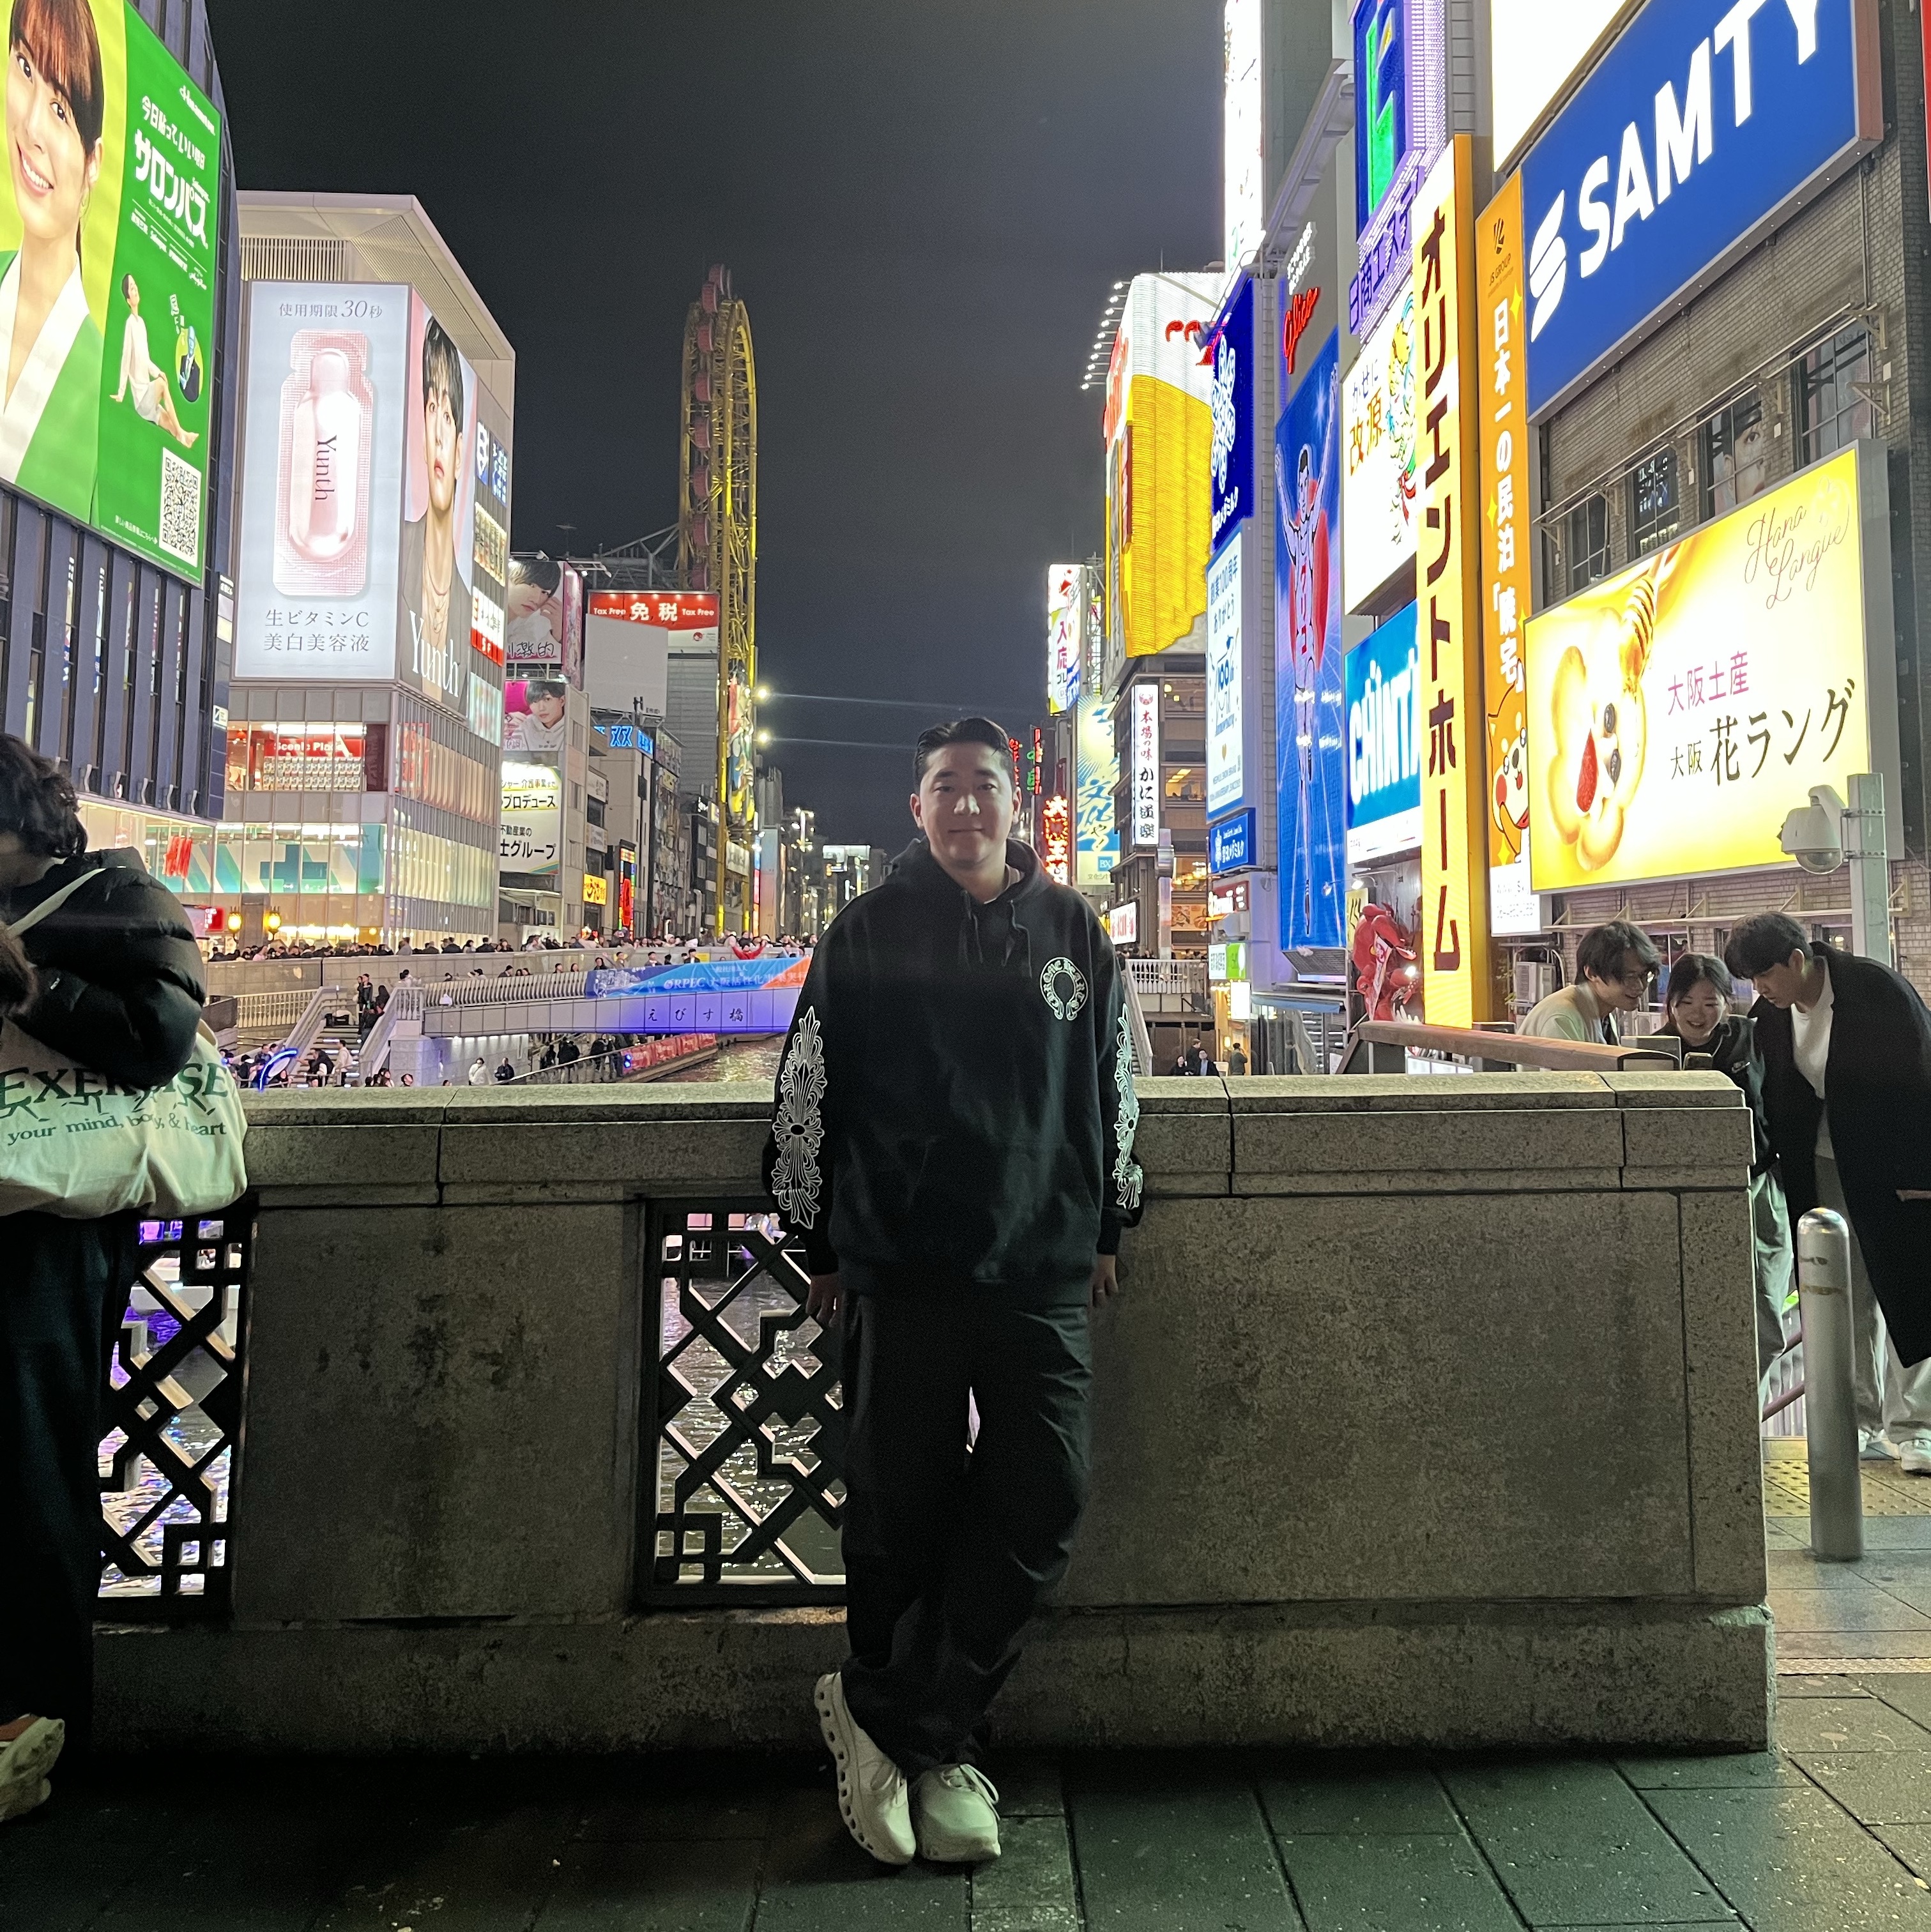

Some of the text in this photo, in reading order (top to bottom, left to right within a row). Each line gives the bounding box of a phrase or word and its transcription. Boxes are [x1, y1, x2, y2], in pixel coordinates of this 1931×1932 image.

[1579, 0, 1819, 278] SAMTY
[134, 128, 208, 250] サロンパス
[1349, 167, 1419, 334] 日商エステ
[279, 300, 383, 318] 使用期限30秒
[1283, 287, 1320, 374] Glico
[315, 435, 337, 502] Yunth
[630, 602, 678, 621] 免税
[1422, 206, 1460, 971] オリエントホーム
[264, 632, 370, 652] 美白美容液
[265, 609, 369, 628] 生ビタミンC
[409, 611, 459, 698] Yunth
[1667, 650, 1750, 716] 大阪土産
[1140, 710, 1154, 761] 本場の味
[1670, 679, 1856, 786] 大阪 花ラング
[501, 794, 556, 809] プロデュース
[1139, 766, 1155, 839] かに道楽
[1099, 860, 1111, 868] BX
[648, 1008, 744, 1022] えびす橋
[0, 1063, 229, 1109] EXESE
[8, 1127, 57, 1146] your
[65, 1115, 123, 1134] mind,
[168, 1113, 180, 1129] &
[185, 1116, 227, 1136] heart
